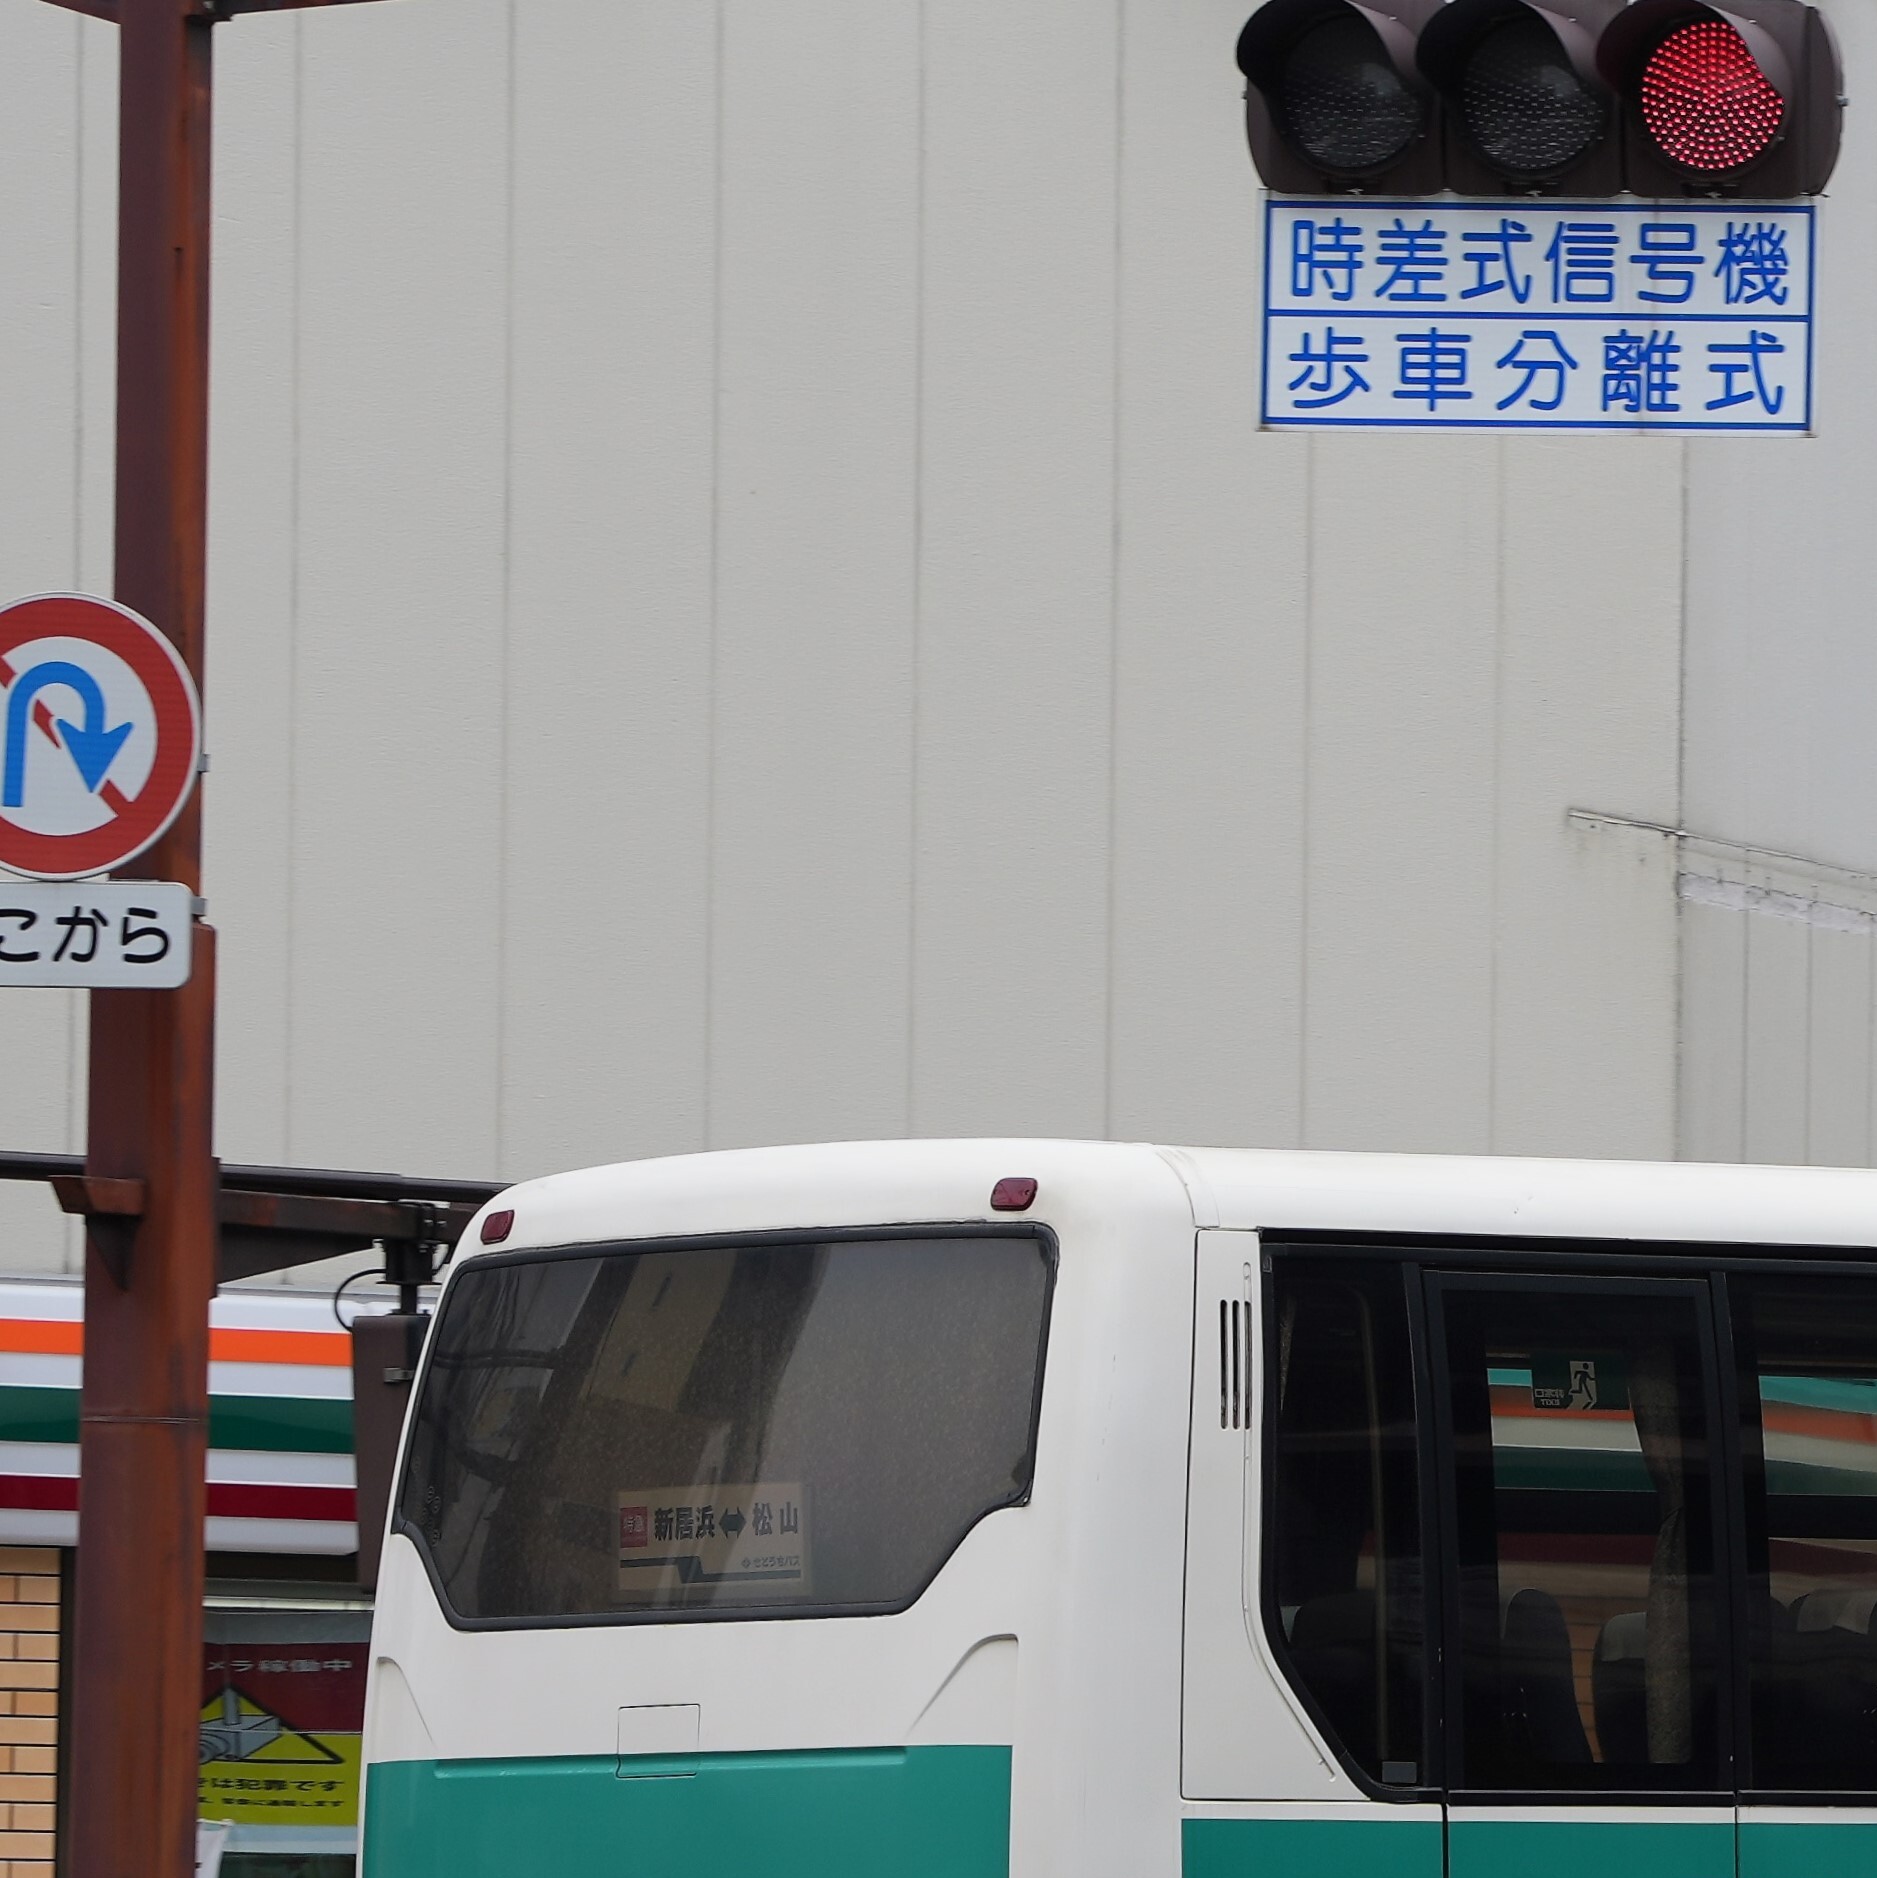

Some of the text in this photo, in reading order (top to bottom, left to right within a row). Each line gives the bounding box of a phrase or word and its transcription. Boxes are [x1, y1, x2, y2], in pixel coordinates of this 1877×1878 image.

[1291, 218, 1789, 305] 時差式信号機
[1289, 327, 1785, 414] 歩車分離式
[654, 1505, 715, 1541] 新居浜
[752, 1502, 798, 1535] 松山
